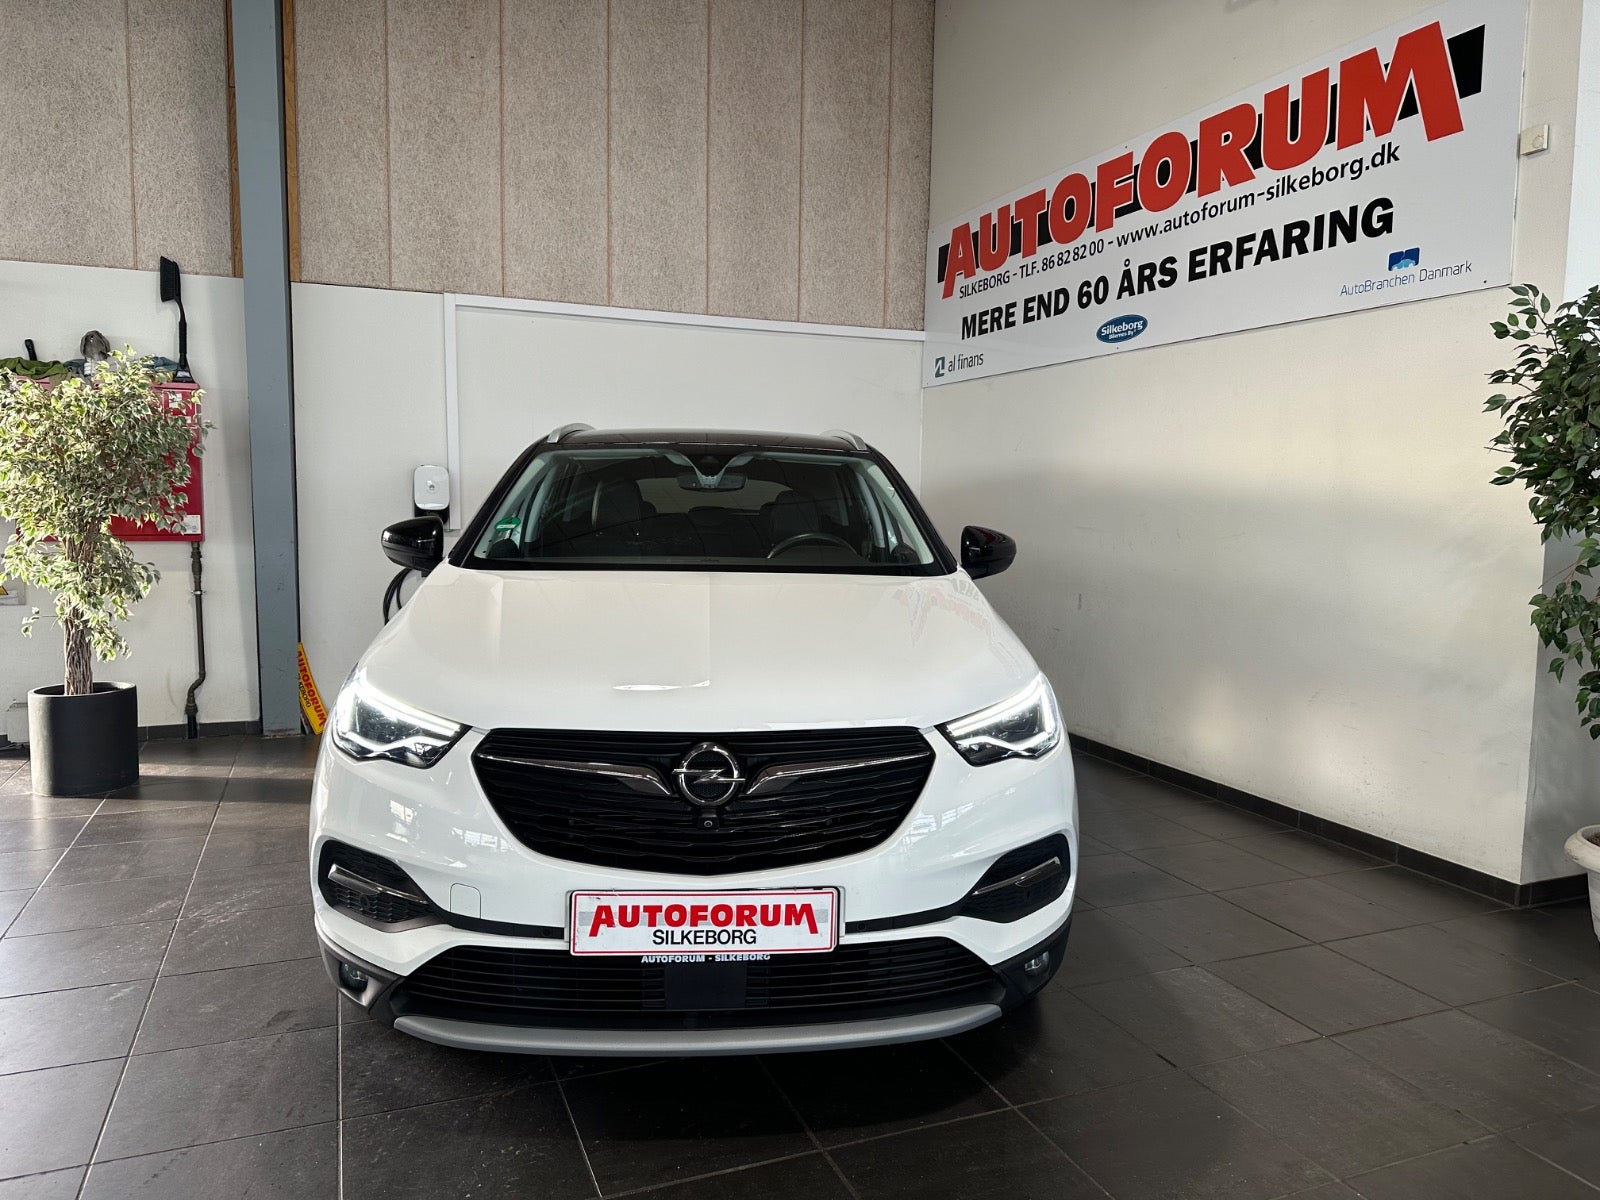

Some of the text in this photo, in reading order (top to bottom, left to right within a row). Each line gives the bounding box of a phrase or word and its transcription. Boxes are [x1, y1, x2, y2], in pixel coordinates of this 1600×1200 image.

[941, 21, 1464, 300] AUTOFORUM
[959, 270, 1010, 299] SILKEBORG
[1019, 260, 1040, 279] TLF.
[1116, 141, 1400, 248] www.autoforum-silkeborg.dk
[961, 197, 1394, 341] MERE END 60 ÅRS ERFARING
[1340, 259, 1473, 297] AutoBranchen Danmark
[1101, 320, 1143, 336] Silkeborg
[947, 353, 984, 372] al finans
[588, 903, 819, 937] AUTOFORUM
[652, 929, 757, 945] SILKEBORG
[640, 954, 706, 964] AUTOFORUM
[714, 953, 771, 962] SILKEBORG
